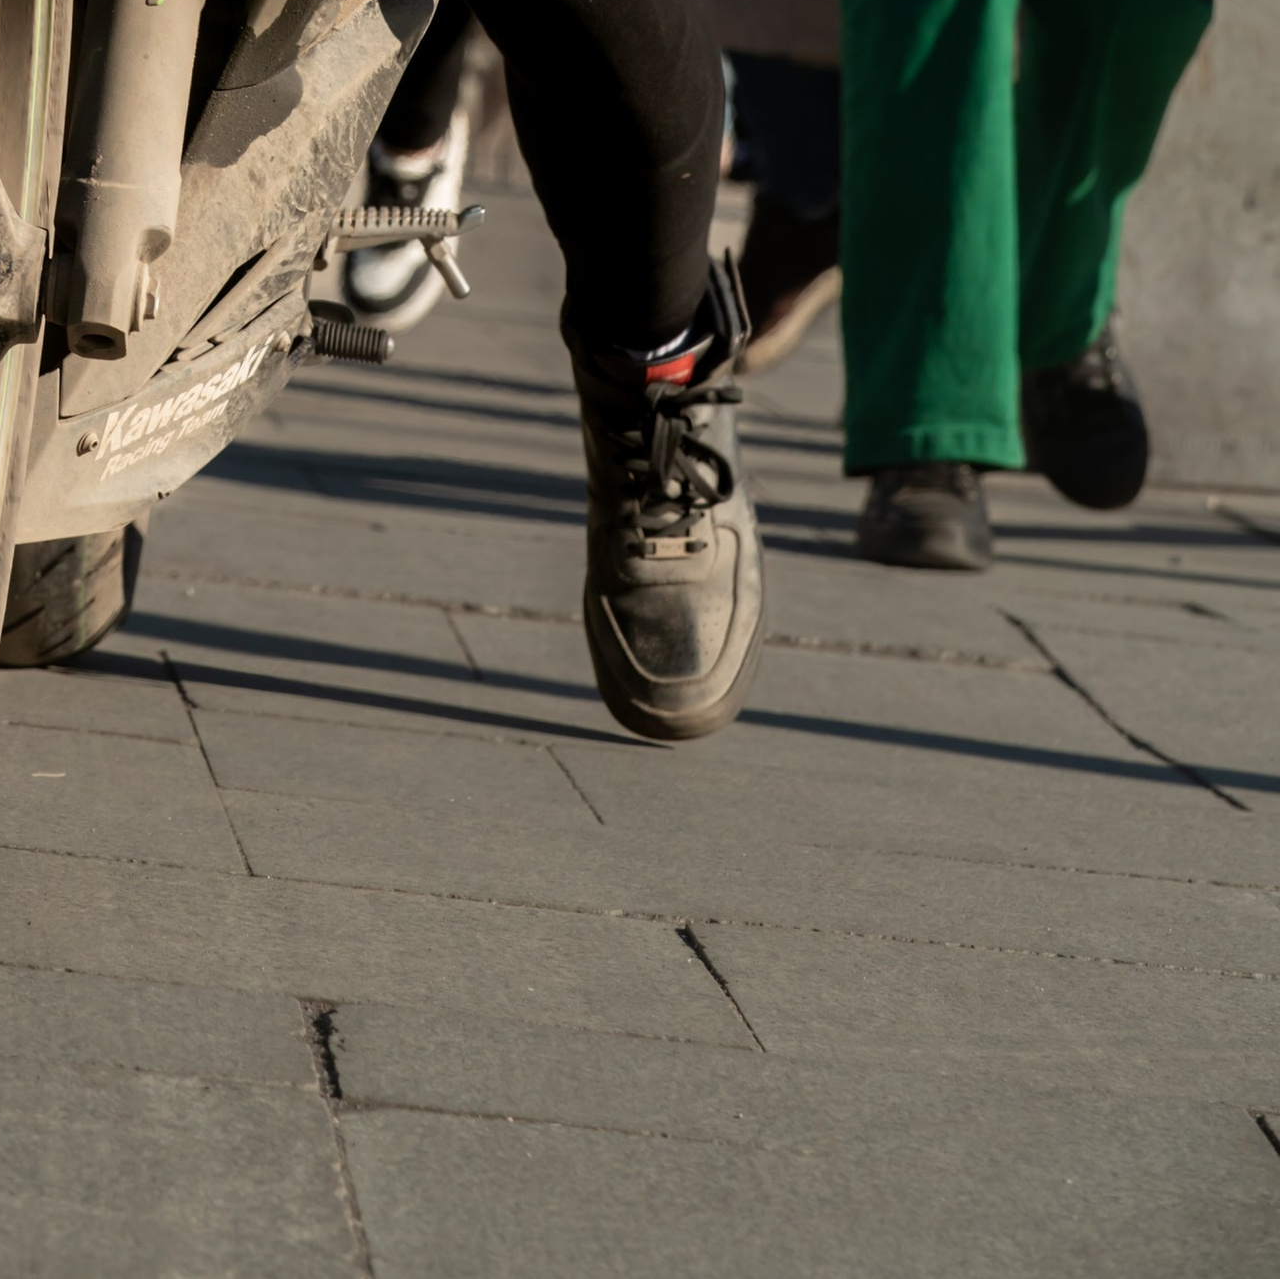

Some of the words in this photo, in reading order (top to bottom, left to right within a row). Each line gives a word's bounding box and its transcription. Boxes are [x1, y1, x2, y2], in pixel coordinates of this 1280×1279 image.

[94, 332, 275, 461] Kawasaki
[99, 430, 176, 482] Racing
[177, 399, 230, 441] Team
